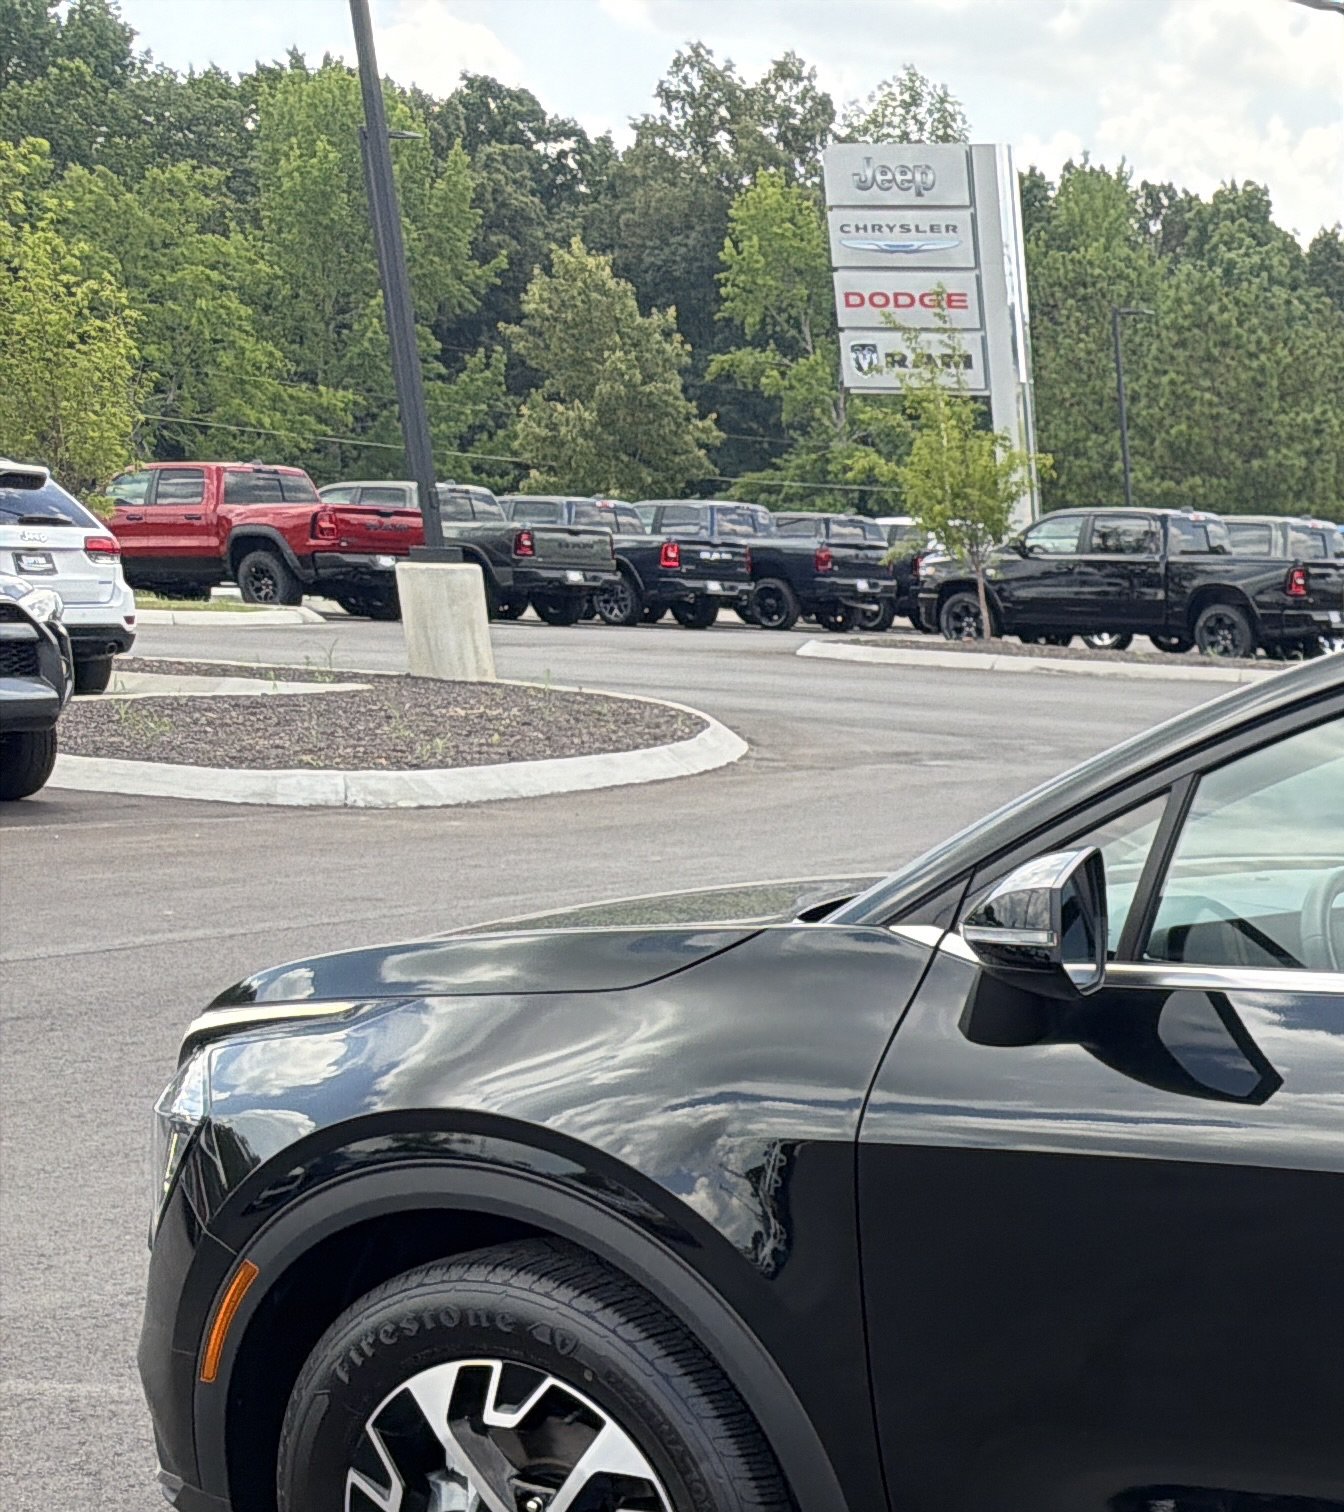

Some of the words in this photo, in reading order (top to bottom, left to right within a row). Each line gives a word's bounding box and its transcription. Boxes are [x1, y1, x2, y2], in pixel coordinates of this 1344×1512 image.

[852, 156, 937, 197] Jeep
[839, 222, 959, 235] CHRYSLER
[843, 290, 970, 310] DODGE
[332, 1304, 519, 1385] Firestone
